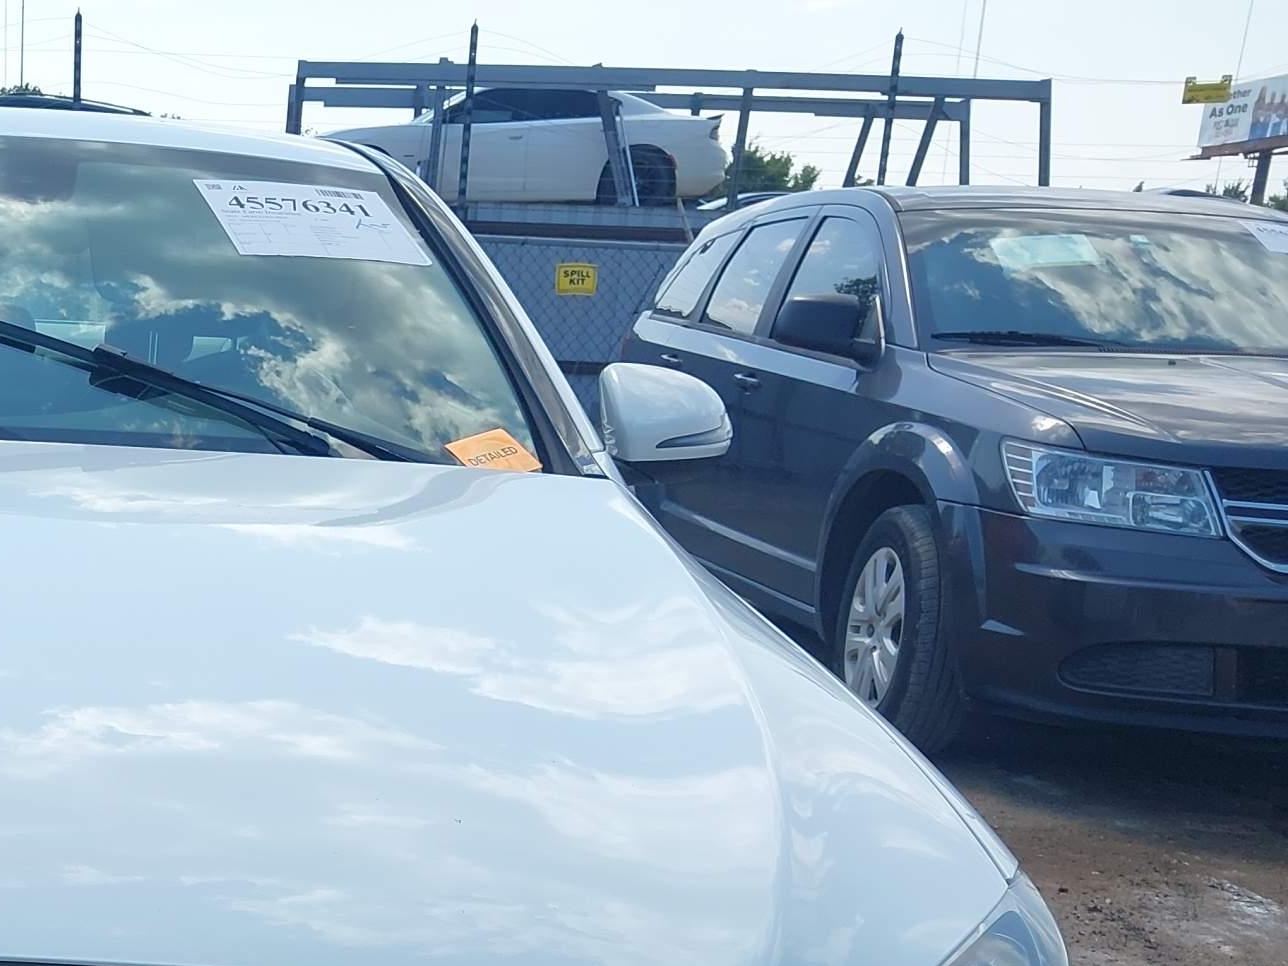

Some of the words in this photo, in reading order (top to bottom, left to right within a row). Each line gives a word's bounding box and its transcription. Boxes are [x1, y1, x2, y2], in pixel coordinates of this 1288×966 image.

[228, 195, 373, 218] 45576341
[563, 270, 591, 279] SPILL
[468, 446, 519, 467] DETAILED
